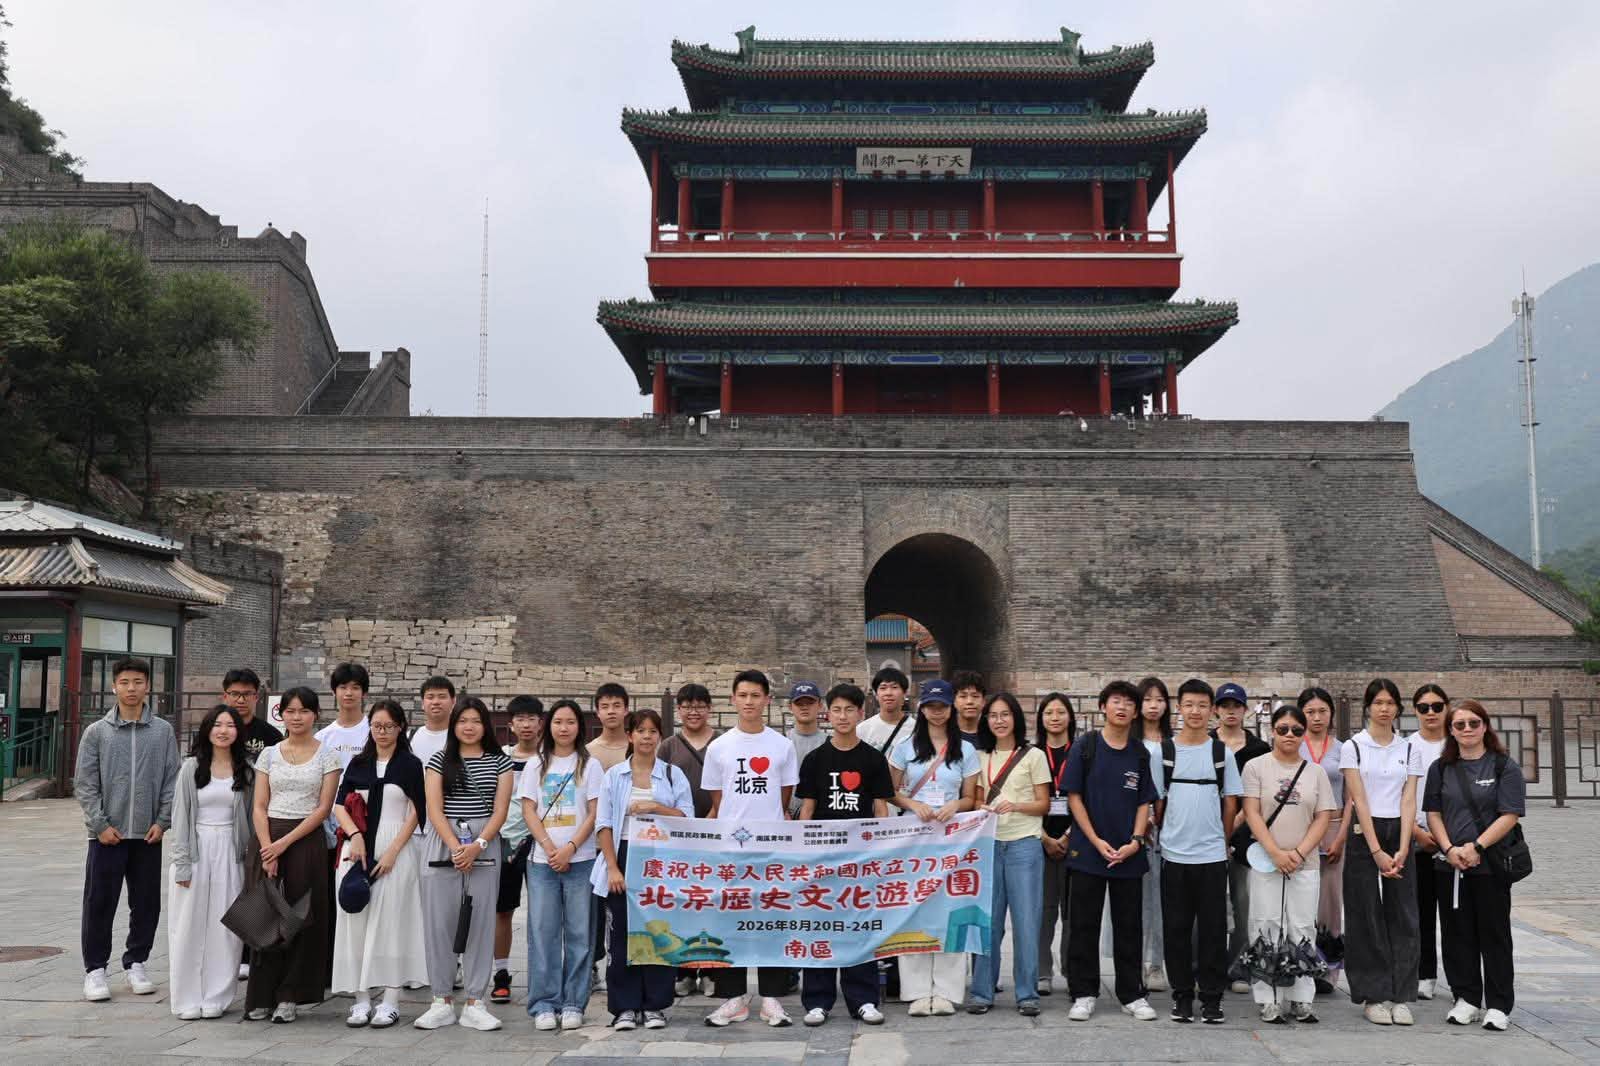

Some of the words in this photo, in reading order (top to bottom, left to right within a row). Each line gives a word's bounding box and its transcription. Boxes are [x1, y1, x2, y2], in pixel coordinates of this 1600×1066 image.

[736, 758, 747, 774] I
[735, 776, 768, 794] 北京
[829, 772, 840, 790] I
[828, 791, 860, 811] 北京
[643, 849, 979, 882] 慶祝中華人民共和國成立77周年
[639, 868, 979, 911] 北京歷史文化遊學團
[737, 919, 883, 932] 2026年8月20日-24日
[785, 939, 832, 959] 南區
